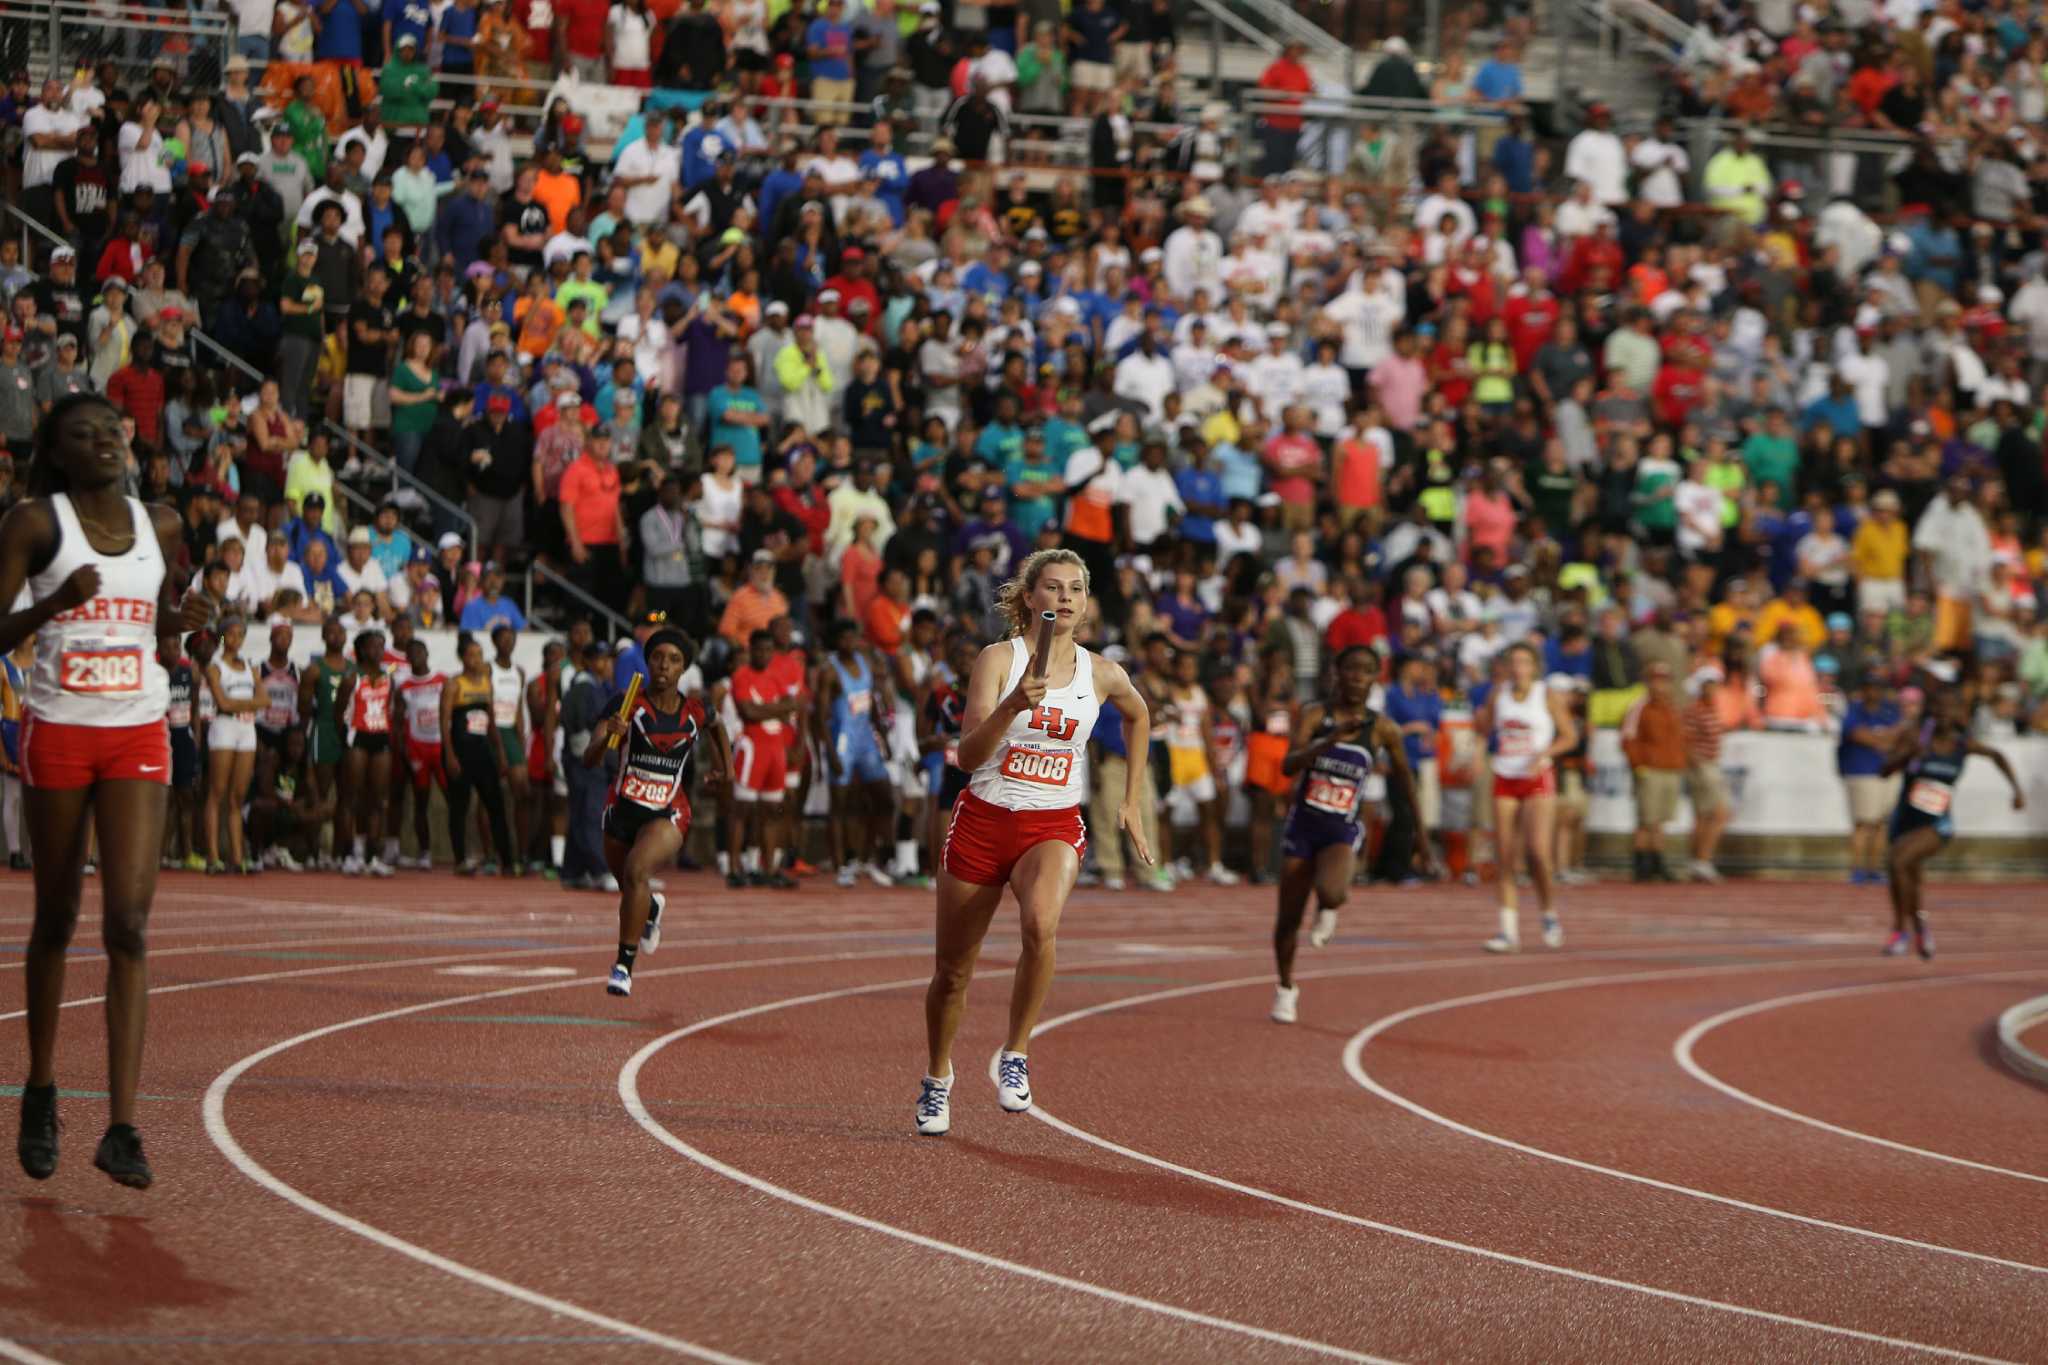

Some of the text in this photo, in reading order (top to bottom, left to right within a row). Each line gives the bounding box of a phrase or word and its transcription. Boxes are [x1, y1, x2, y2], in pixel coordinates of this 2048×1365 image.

[66, 655, 138, 688] 2303
[1008, 751, 1068, 780] 3008
[625, 777, 668, 802] 2708
